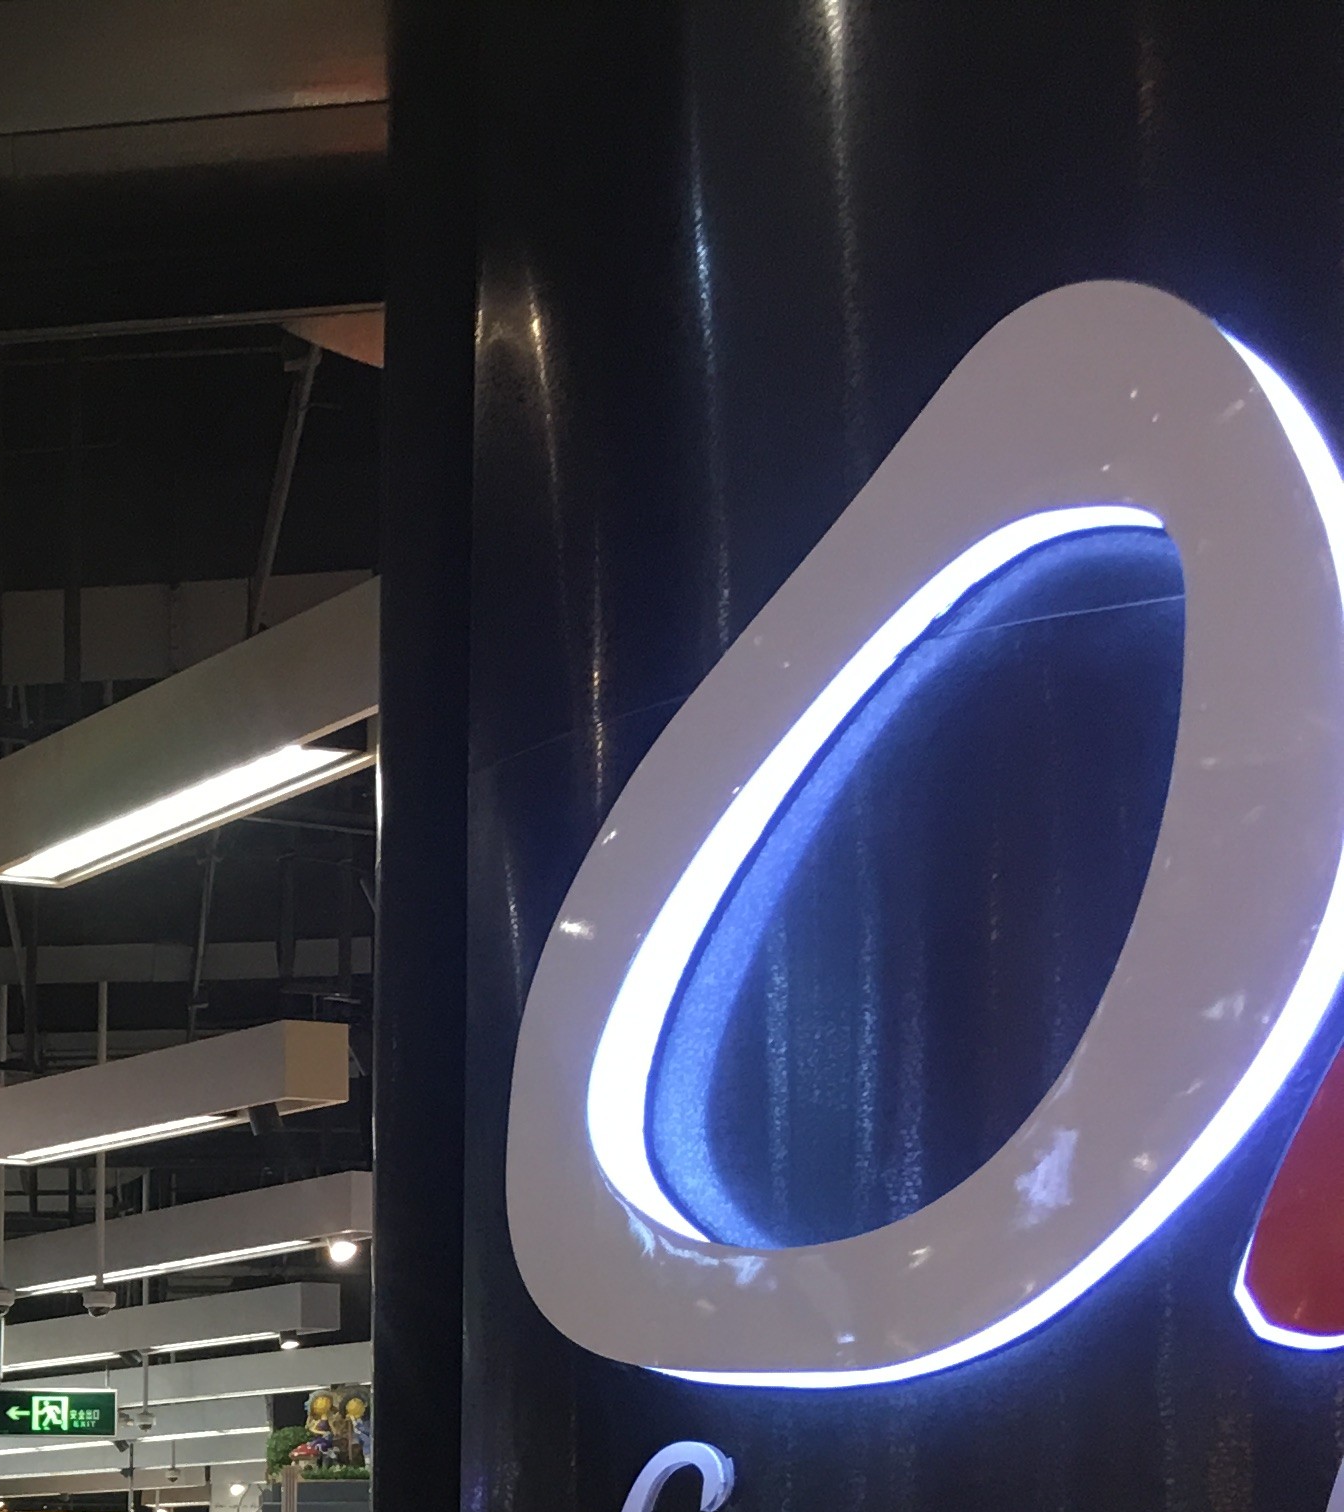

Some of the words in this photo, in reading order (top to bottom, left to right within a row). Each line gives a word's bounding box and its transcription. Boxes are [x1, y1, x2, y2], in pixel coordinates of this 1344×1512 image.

[69, 1408, 100, 1420] 安全出口
[73, 1420, 97, 1428] EXIT
